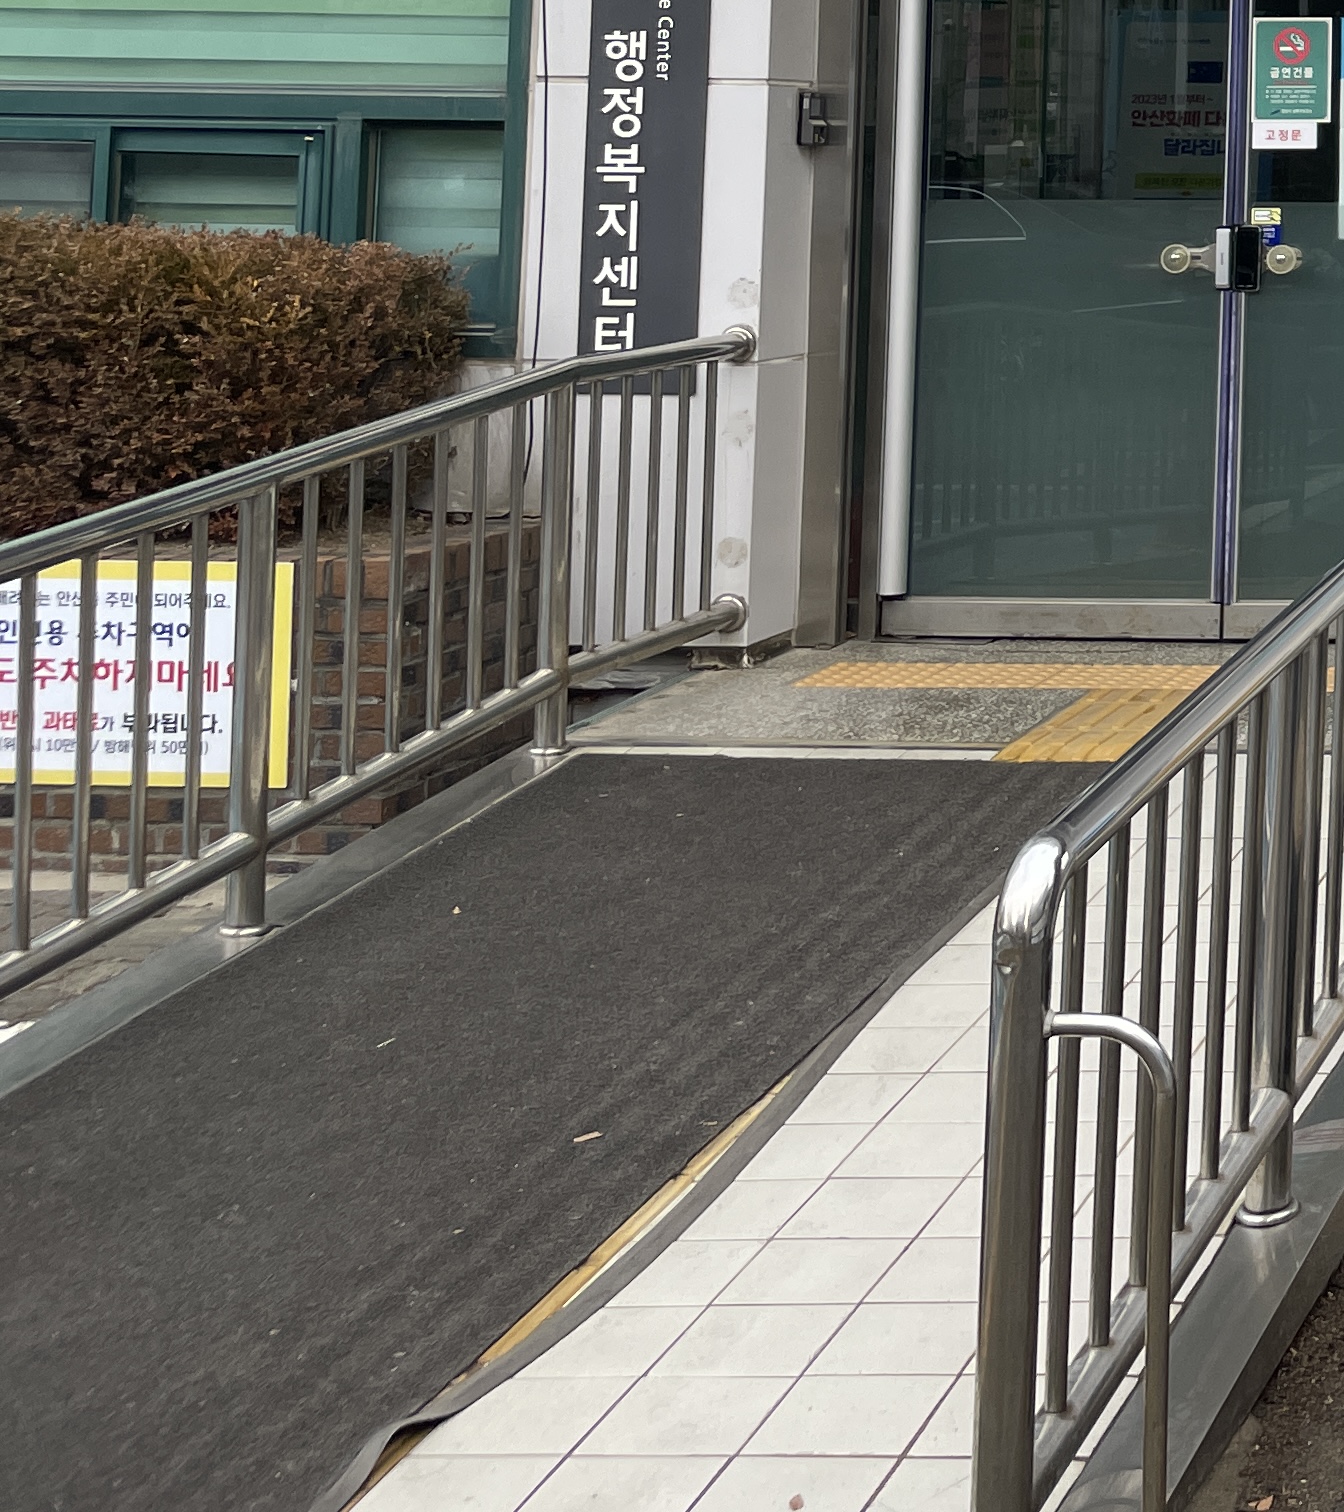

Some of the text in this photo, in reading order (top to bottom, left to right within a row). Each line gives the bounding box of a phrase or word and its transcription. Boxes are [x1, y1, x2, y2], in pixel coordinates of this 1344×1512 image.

[655, 16, 674, 81] Center
[1131, 110, 1201, 128] 안산화폐
[1265, 129, 1302, 142] 고정문
[593, 29, 648, 352] 행정복지센터
